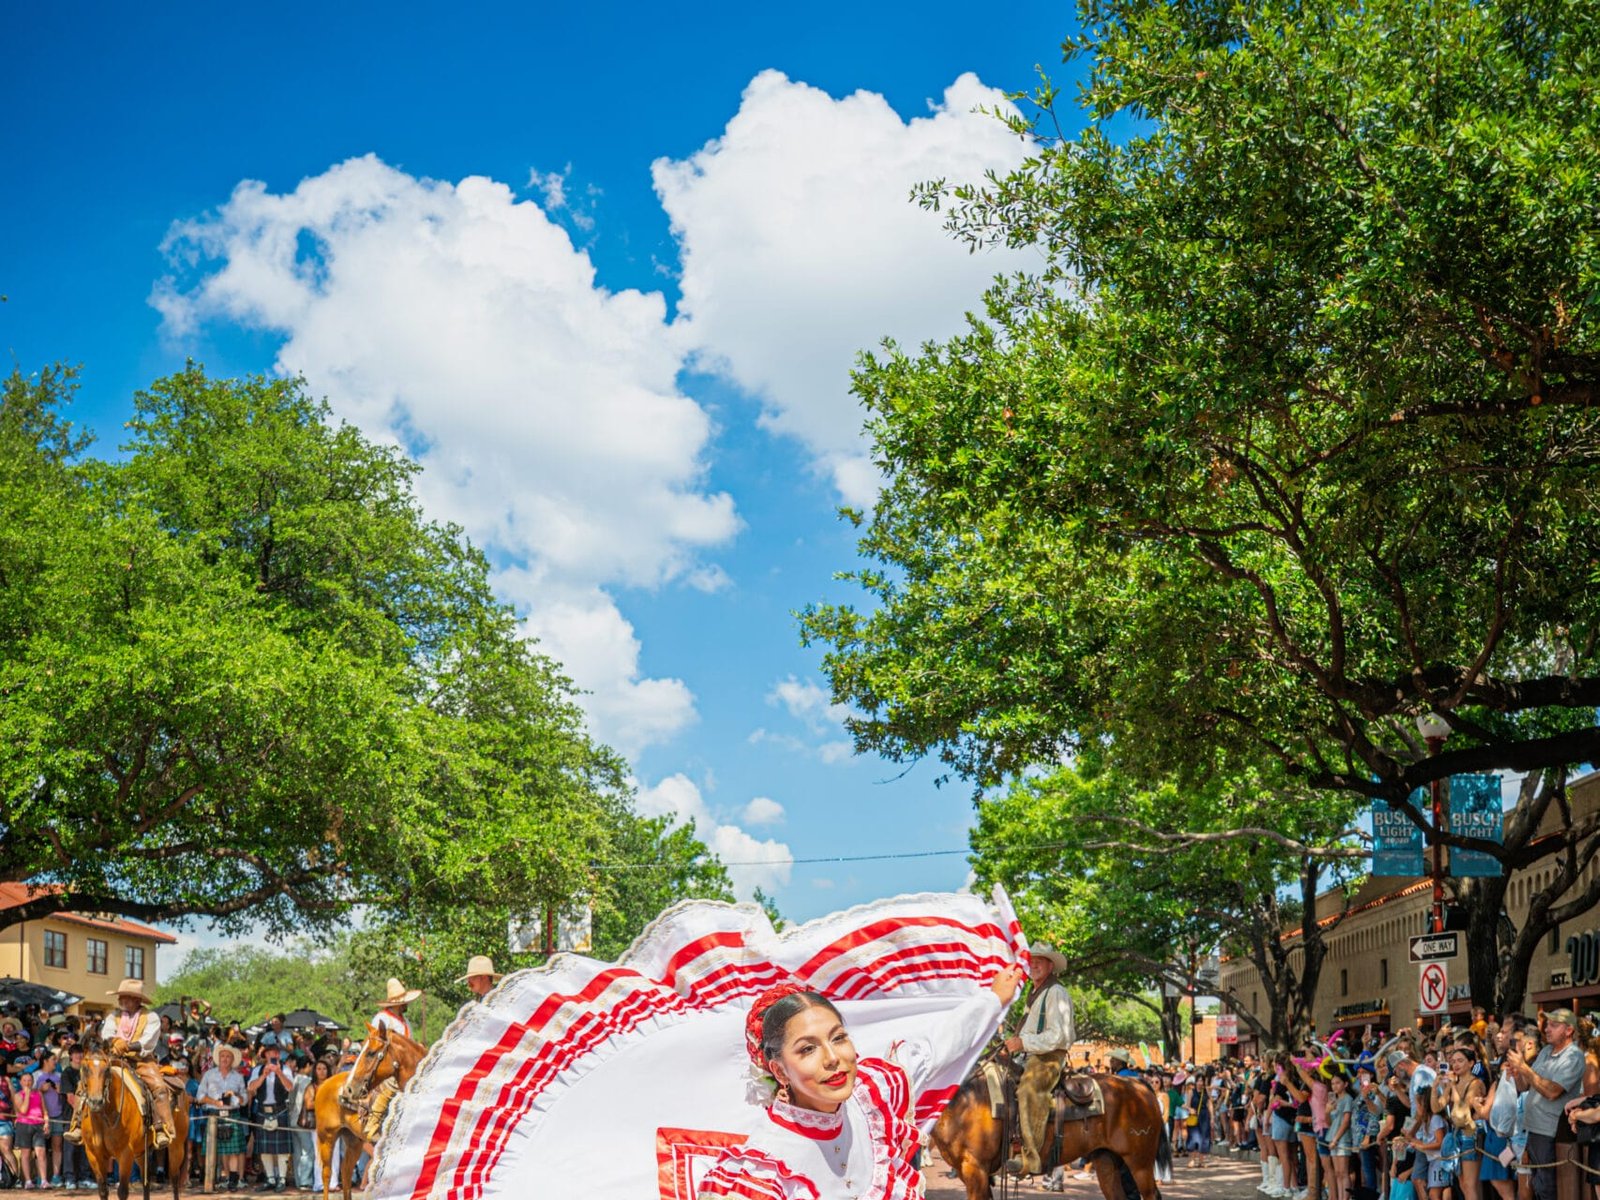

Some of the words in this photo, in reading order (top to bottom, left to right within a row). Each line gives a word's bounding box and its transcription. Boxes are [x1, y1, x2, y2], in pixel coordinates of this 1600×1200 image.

[1374, 811, 1415, 826] BUSC
[1452, 812, 1501, 827] BUSCH
[1379, 827, 1414, 837] LIGHT
[1423, 941, 1436, 953] ONE
[1438, 939, 1453, 951] WAY
